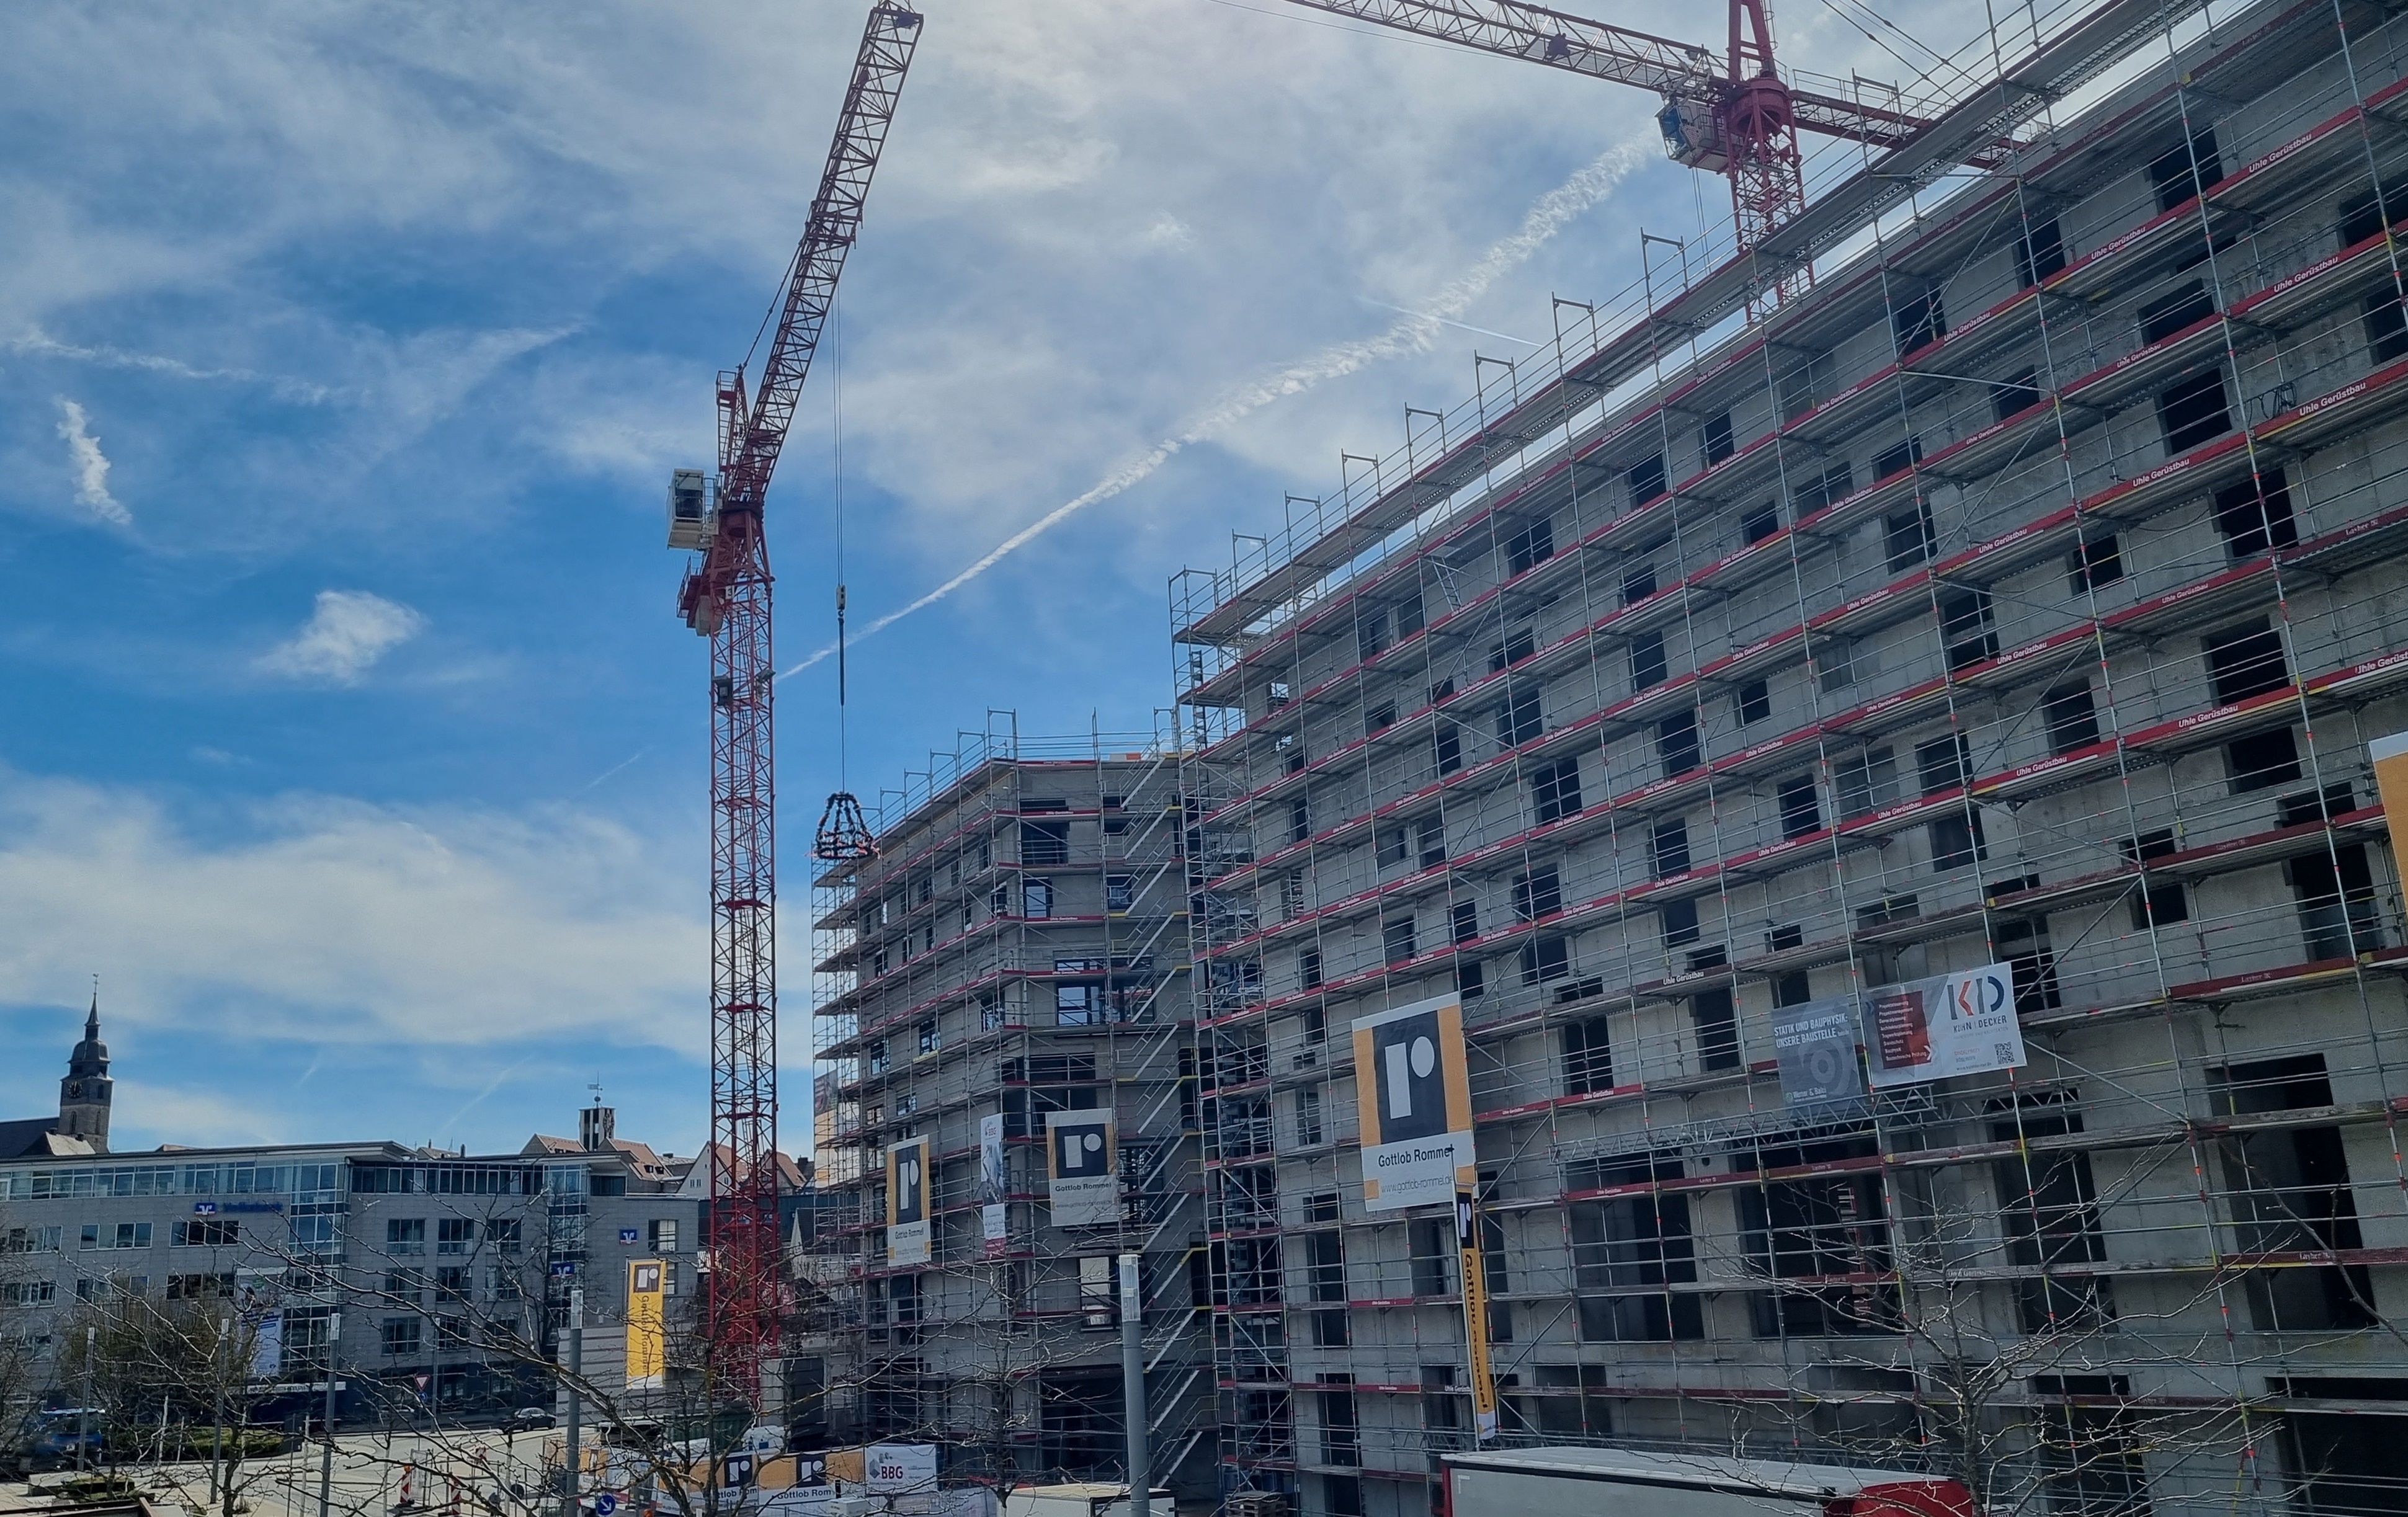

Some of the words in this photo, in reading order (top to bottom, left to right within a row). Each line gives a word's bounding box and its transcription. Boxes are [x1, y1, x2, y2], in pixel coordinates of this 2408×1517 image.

[2249, 157, 2268, 173] Uhle
[2268, 133, 2312, 162] Gerüstbau
[2091, 245, 2107, 260] Uhle
[2108, 226, 2146, 250] Gerüstbau
[2273, 277, 2293, 292] Uhle
[2294, 256, 2339, 284] Gerüstbau
[1944, 328, 1958, 342] Uhle
[1958, 313, 1991, 336] Gerüstbau
[2116, 355, 2131, 368] Uhle
[2131, 343, 2162, 362] Gerüstbau
[2299, 403, 2319, 416] Uhle
[2321, 381, 2366, 407] Gerüstbau
[2133, 473, 2150, 487] Uhle
[2151, 458, 2190, 479] Gerüstbau
[1979, 540, 1994, 554] Uhle
[1994, 528, 2027, 548] Gerüstbau
[2162, 592, 2176, 604] Uhle
[2177, 583, 2208, 599] Gerüstbau
[1997, 651, 2012, 664] Uhle
[2012, 641, 2047, 659] Gerüstbau
[2378, 651, 2408, 667] Gerüst
[2178, 714, 2196, 728] Uhle
[2197, 705, 2239, 723] Gerüstbau
[2016, 764, 2032, 776] Uhle
[2032, 755, 2067, 772] Gerüstbau
[1878, 808, 1891, 819] Uhle
[1892, 801, 1922, 816] Gerüstbau
[1663, 977, 1675, 985] Uhle
[1676, 971, 1704, 982] Gerüstbau
[1774, 1025, 1795, 1037] STATIK
[1796, 1021, 1809, 1033] UND
[1810, 1012, 1848, 1030] BAUPHYSIK:
[1978, 1015, 2007, 1028] DECKER
[1775, 1035, 1800, 1049] UNSERE
[1801, 1028, 1837, 1044] BAUSTELLE
[1378, 1151, 1411, 1167] Gottlob
[1414, 1147, 1450, 1162] Romme
[1055, 1183, 1081, 1192] Gottlob
[1083, 1182, 1112, 1190] Rommel
[908, 1227, 924, 1238] Rommel
[881, 1466, 903, 1479] BBG
[777, 1490, 809, 1500] Gottlob
[811, 1489, 831, 1498] Rom
